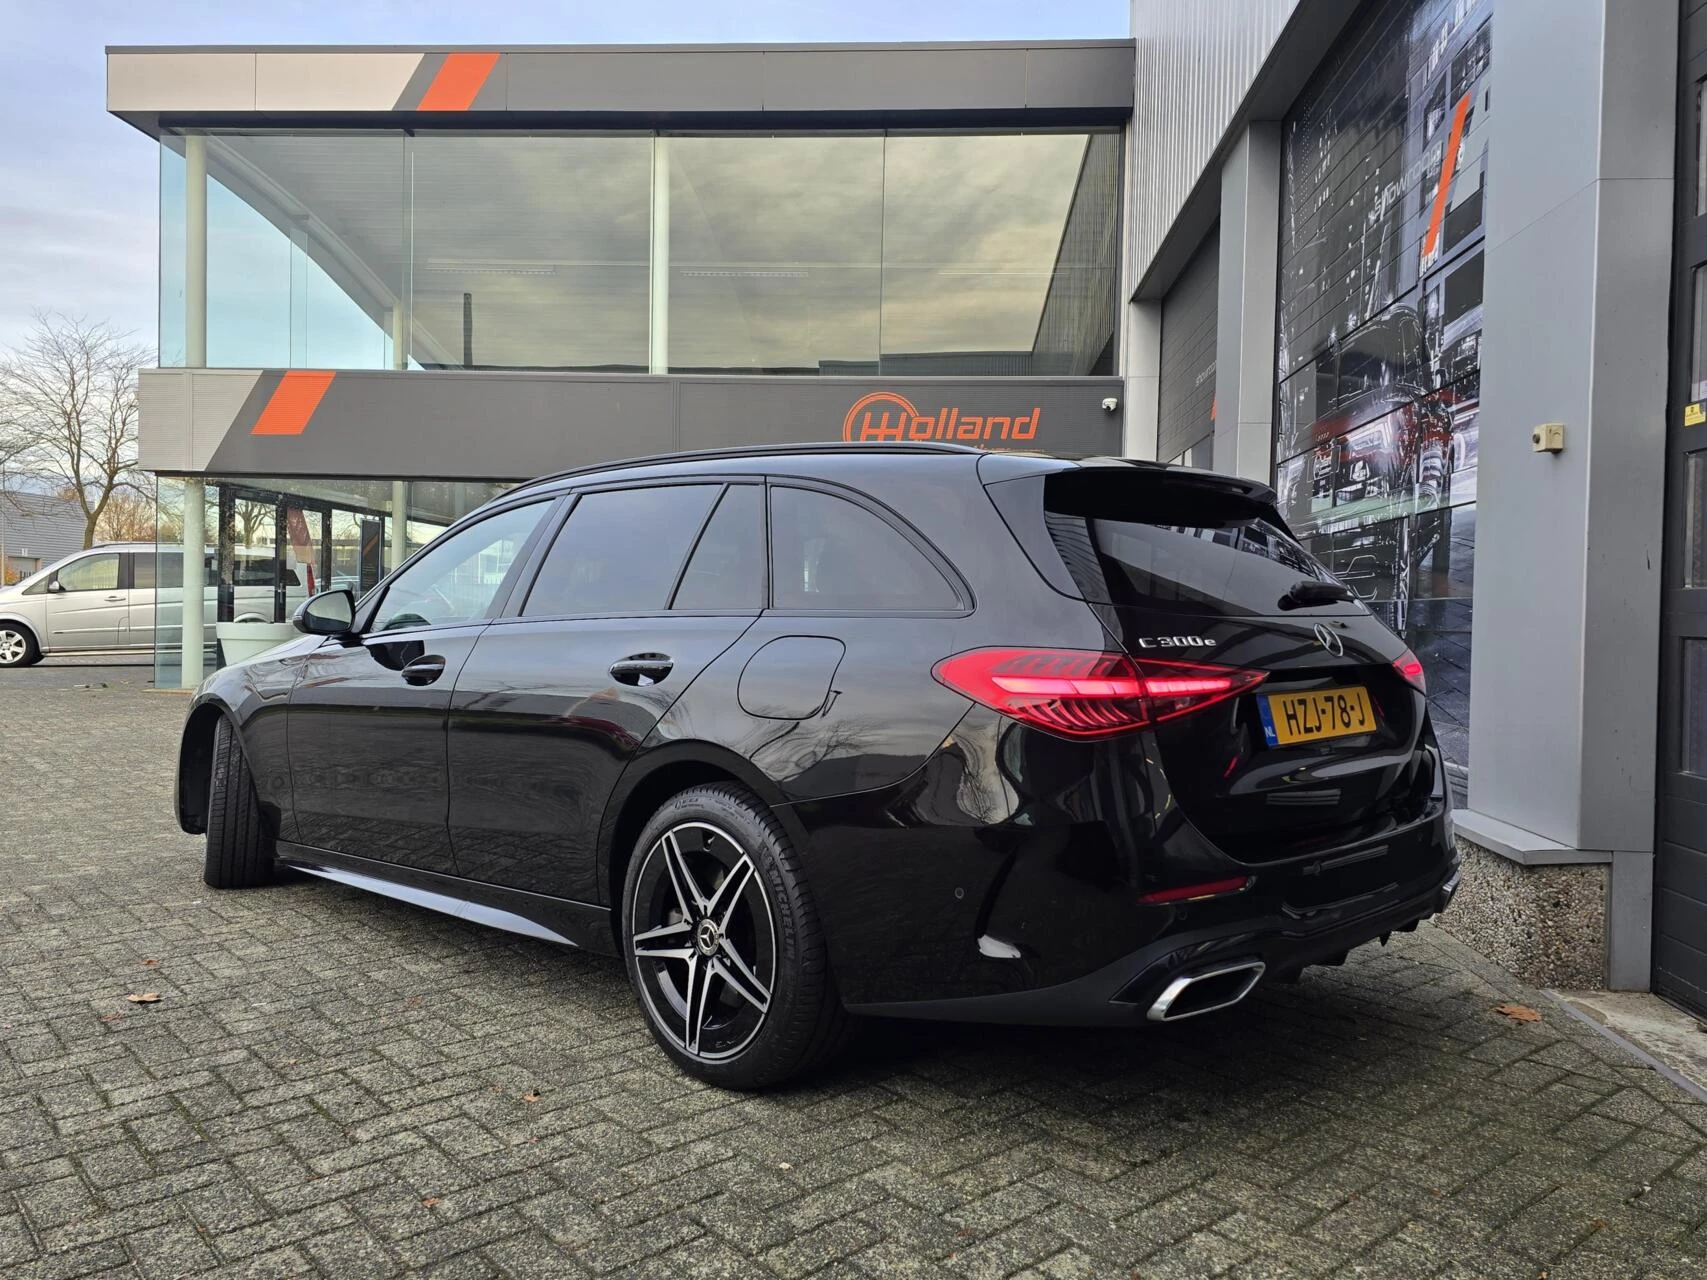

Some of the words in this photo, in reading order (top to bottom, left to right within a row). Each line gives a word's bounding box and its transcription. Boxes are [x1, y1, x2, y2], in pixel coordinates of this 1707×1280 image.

[859, 406, 1041, 442] Holland
[1264, 726, 1276, 737] NL
[1282, 692, 1366, 736] HZJ-78-J
